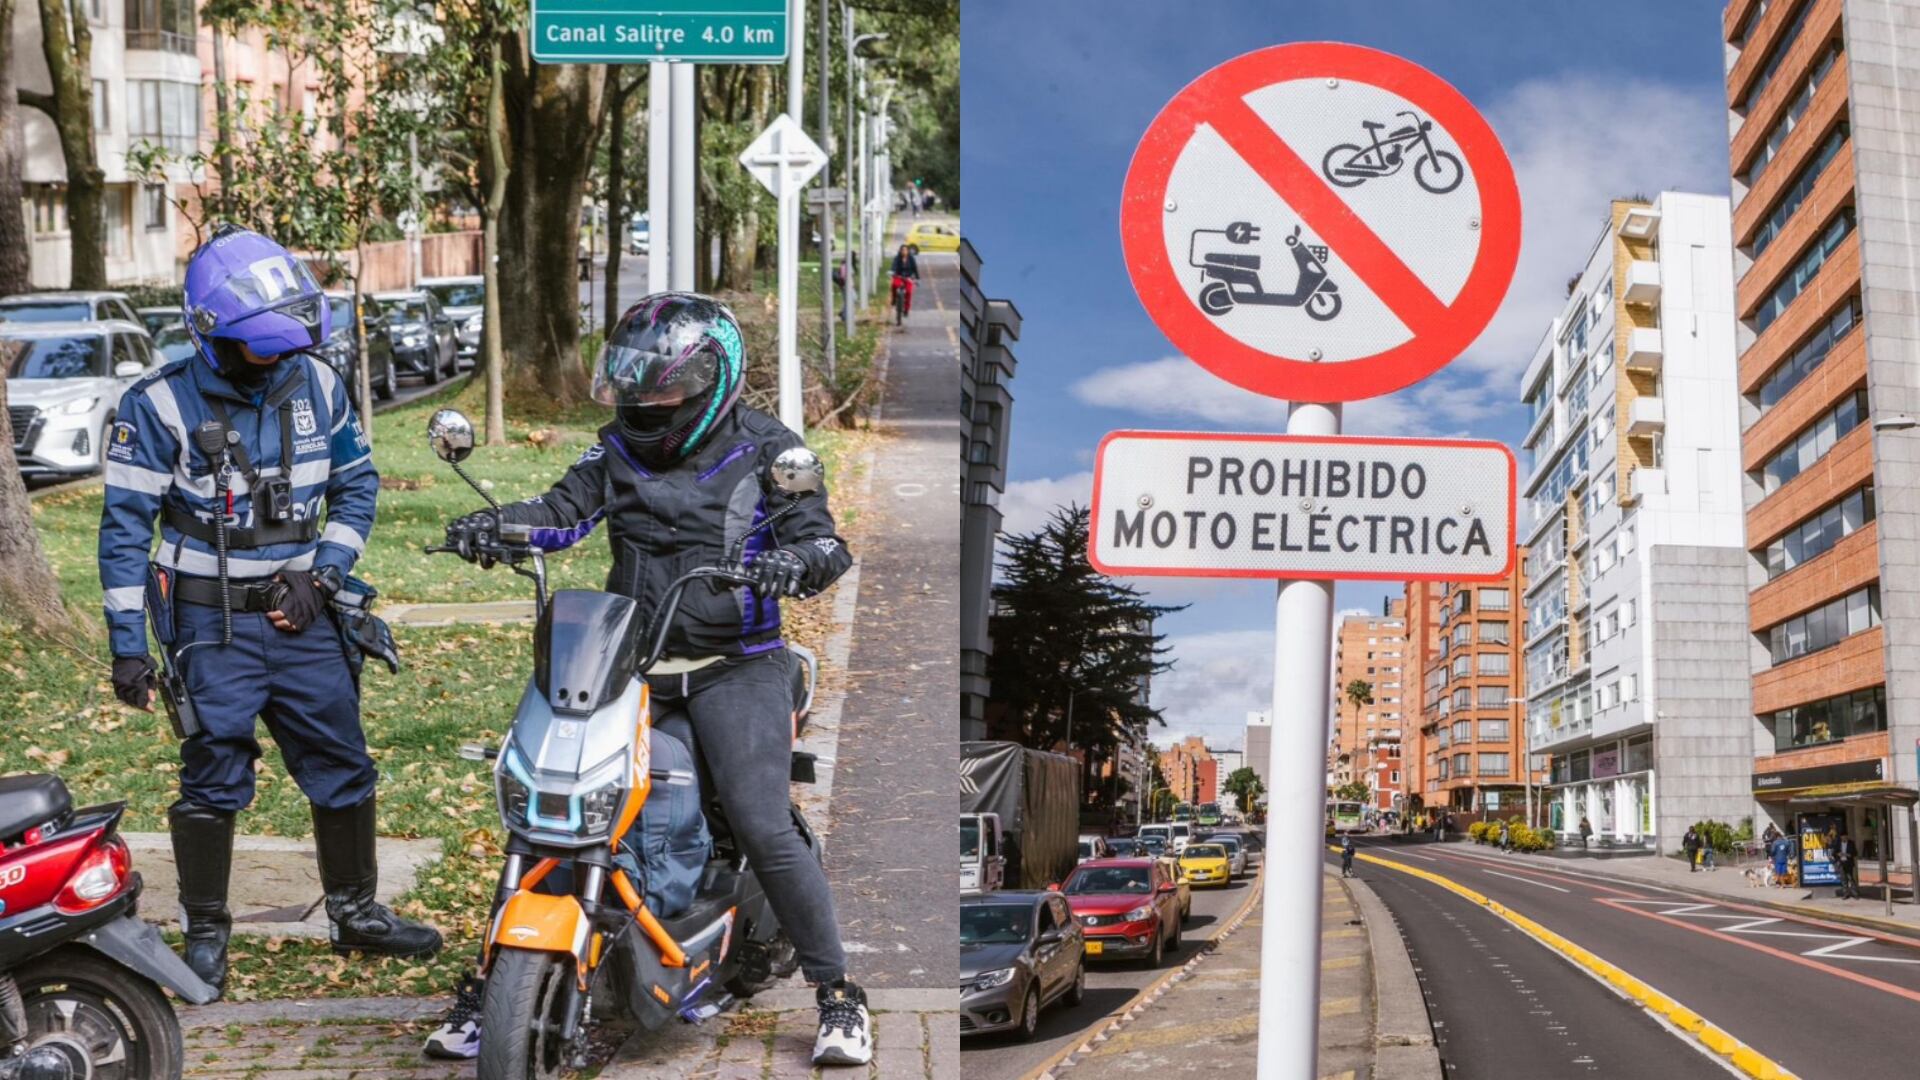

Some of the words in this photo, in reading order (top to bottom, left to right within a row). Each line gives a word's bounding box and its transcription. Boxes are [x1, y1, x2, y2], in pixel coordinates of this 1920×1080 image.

[546, 24, 606, 43] Canal
[615, 24, 685, 43] Salitre
[702, 25, 734, 44] 4.0
[743, 25, 775, 44] km
[1186, 456, 1427, 499] PROHIBIDO
[1113, 510, 1237, 550] MOTO
[1252, 507, 1492, 556] ELÉCTRICA
